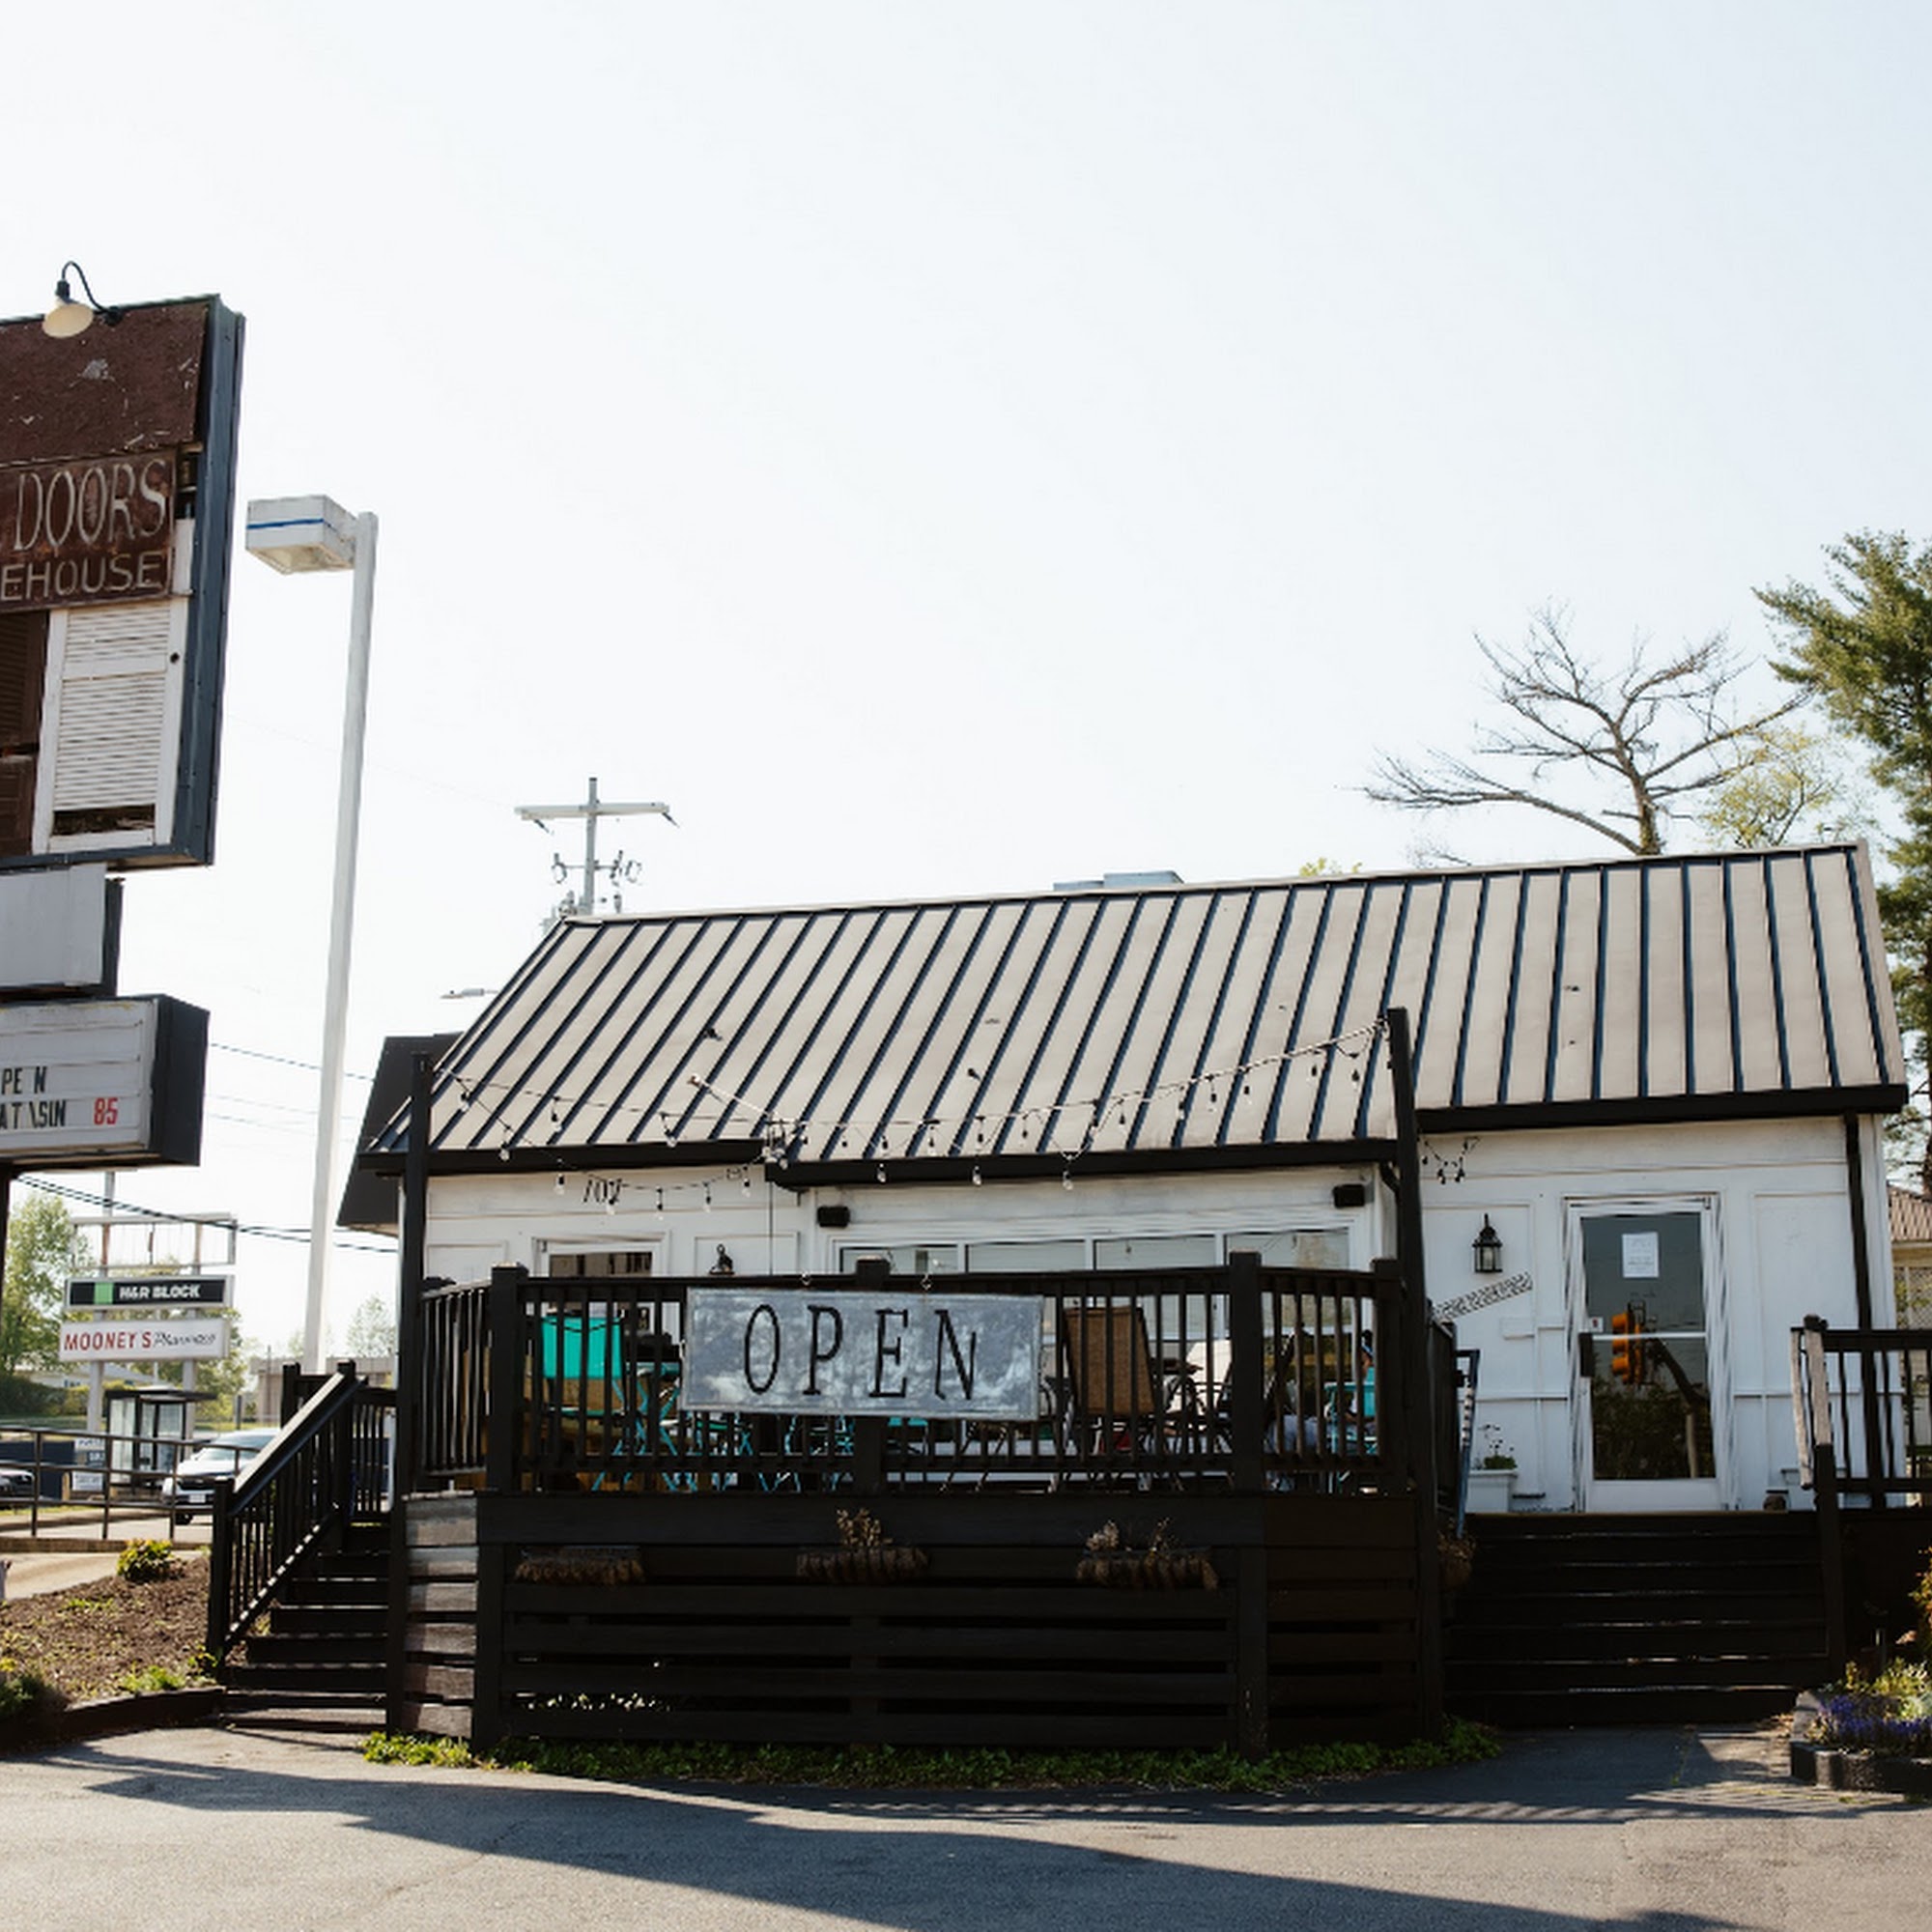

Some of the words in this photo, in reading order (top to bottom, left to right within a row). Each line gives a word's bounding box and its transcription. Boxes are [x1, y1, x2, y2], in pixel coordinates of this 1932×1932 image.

[14, 458, 166, 551] DOORS
[94, 1097, 118, 1125] 85
[119, 1286, 150, 1299] H&R
[152, 1284, 201, 1298] BLOCK
[744, 1304, 977, 1400] OPEN
